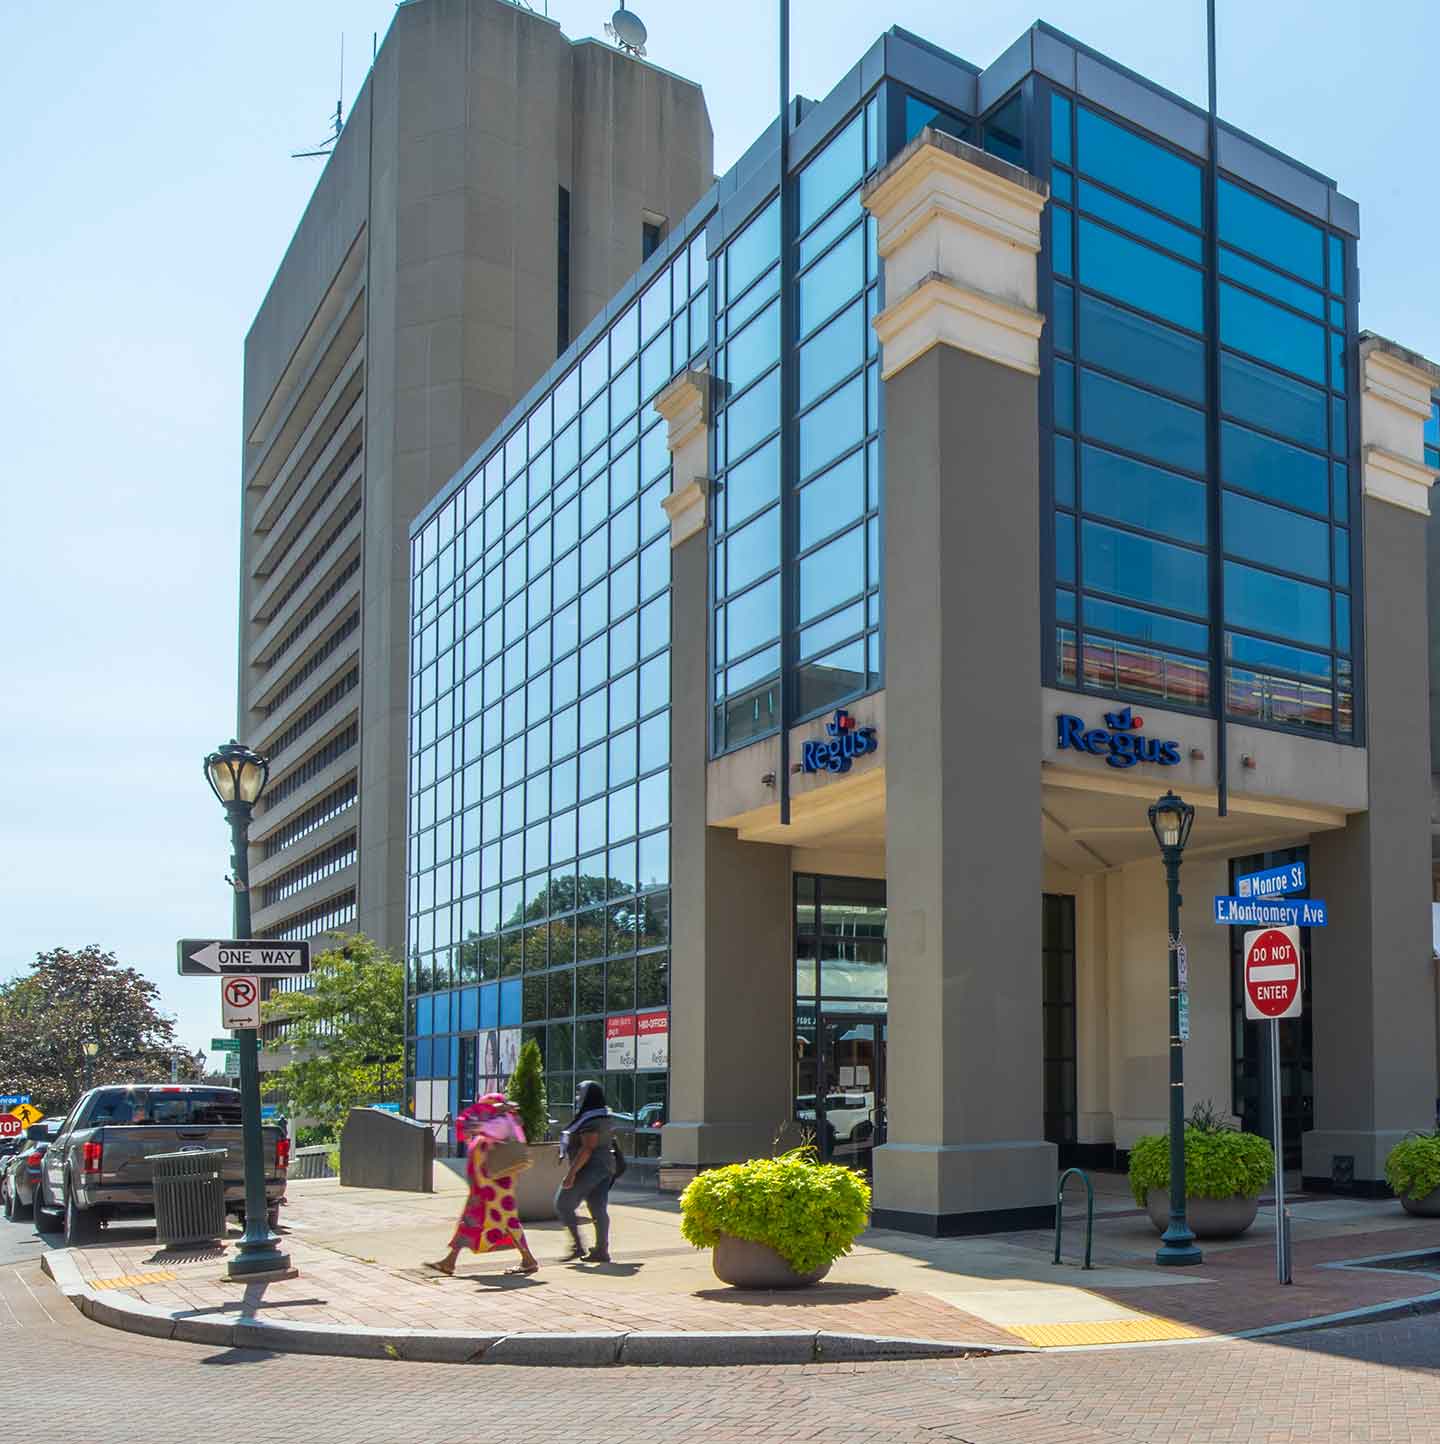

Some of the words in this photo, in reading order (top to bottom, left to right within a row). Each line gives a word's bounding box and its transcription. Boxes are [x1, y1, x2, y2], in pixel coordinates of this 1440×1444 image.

[802, 727, 877, 773] Regus
[1056, 713, 1181, 768] Regus
[1253, 874, 1287, 896] Monroe
[1291, 867, 1302, 887] St
[1303, 904, 1324, 923] Ave
[218, 951, 252, 964] ONE
[261, 951, 295, 964] WAY
[1253, 948, 1267, 962] DO
[1272, 945, 1291, 960] NOT
[234, 984, 251, 1003] P
[1257, 985, 1288, 1000] ENTER
